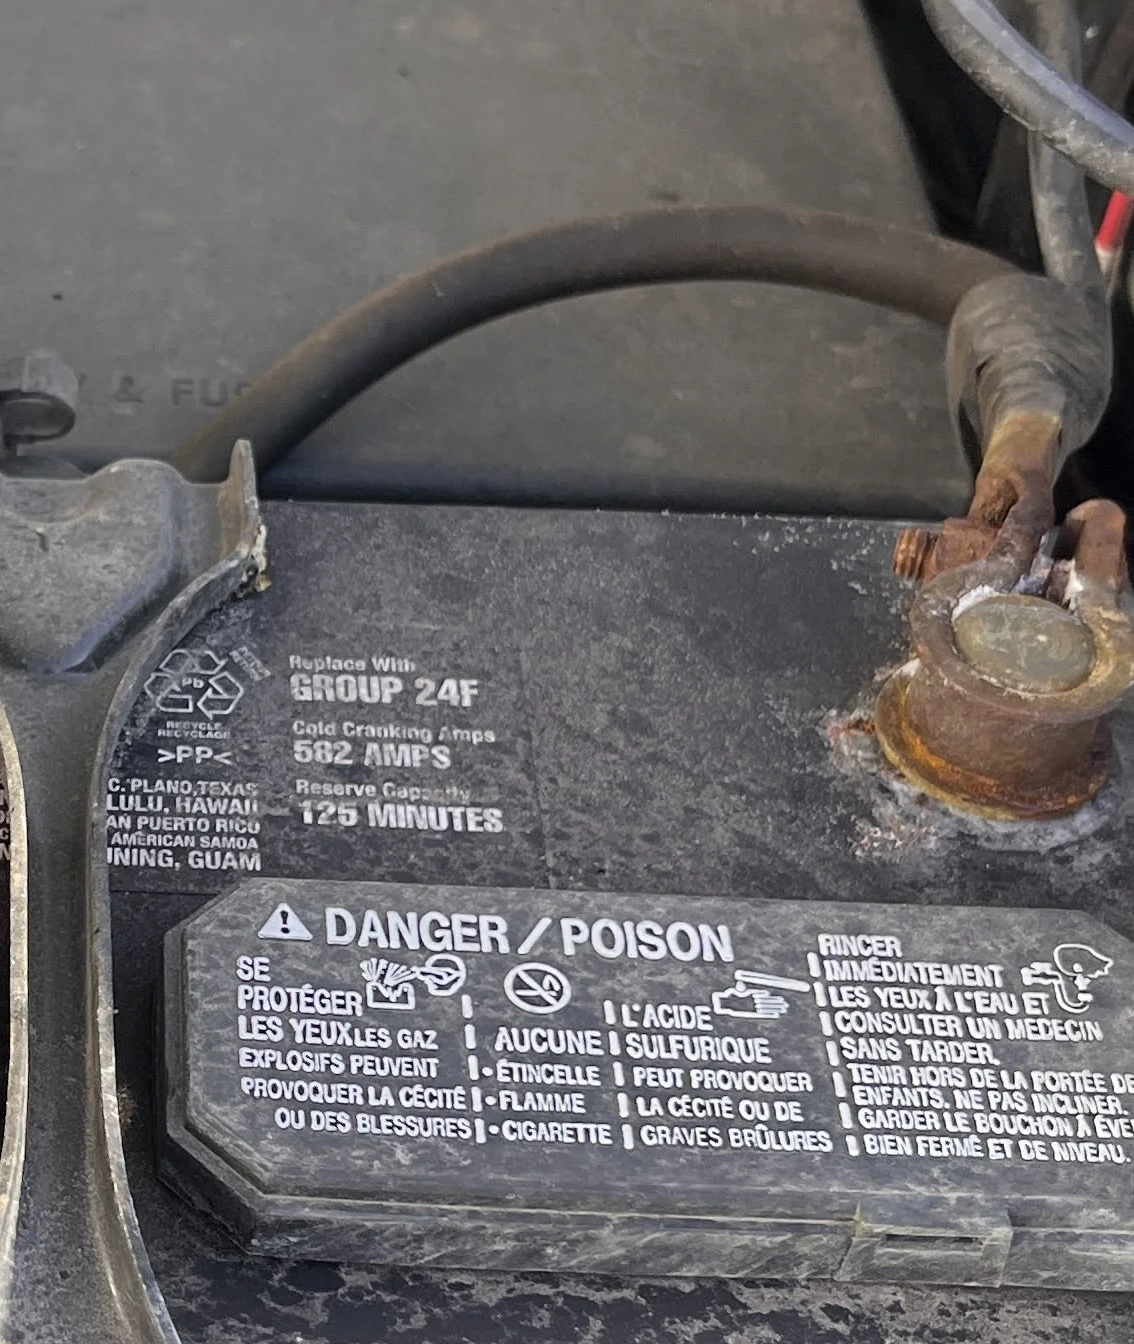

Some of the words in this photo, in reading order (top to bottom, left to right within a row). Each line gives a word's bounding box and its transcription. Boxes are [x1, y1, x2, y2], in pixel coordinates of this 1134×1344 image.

[290, 655, 366, 672] Replace
[371, 656, 416, 673] With
[289, 674, 403, 704] GROUP
[414, 678, 479, 707] 24F
[292, 720, 337, 737] Cold
[342, 721, 433, 744] Cranking
[438, 726, 496, 745] Amps
[293, 739, 354, 765] 582
[364, 742, 452, 770] AMPS
[295, 778, 377, 797] Reserve
[175, 796, 259, 815] HAWAII
[298, 800, 359, 827] 125
[367, 803, 505, 833] MINUTES
[136, 815, 211, 832] PUERTO
[216, 817, 262, 834] RICO
[110, 832, 196, 848] AMERICAN
[199, 835, 259, 851] SAMOA
[187, 850, 262, 872] GUAM
[324, 906, 511, 954] DANGER
[560, 917, 736, 963] POISON
[817, 933, 903, 958] RINCER
[236, 955, 272, 983] SE
[823, 957, 1005, 988] IMMÉDIATEMENT
[237, 983, 364, 1017] PROTÉGER
[828, 985, 871, 1009] LES
[873, 986, 933, 1011] YEUX
[954, 991, 1020, 1016] L'EAU
[1022, 992, 1050, 1016] ET
[237, 1014, 285, 1043] LES
[289, 1018, 354, 1048] YEUX
[353, 1027, 393, 1049] LES
[397, 1028, 440, 1051] GAZ
[621, 1003, 714, 1032] L'ACIDE
[833, 1010, 964, 1039] CONSULTER
[966, 1016, 1002, 1041] UN
[494, 1026, 605, 1056] AUCUNE
[625, 1032, 773, 1065] SULFURIQUE
[839, 1037, 904, 1061] SANS
[904, 1038, 1001, 1066] TARDER.
[238, 1046, 346, 1076] EXPLOSIFS
[349, 1053, 440, 1079] PEUVENT
[496, 1057, 603, 1088] ÉTINCELLE
[846, 1062, 908, 1086] TENIR
[910, 1065, 967, 1089] HORS
[969, 1068, 999, 1091] DE
[1001, 1070, 1028, 1092] LA
[1030, 1068, 1109, 1094] PORTÉE
[240, 1076, 365, 1107] PROVOQUER
[367, 1085, 396, 1108] LA
[398, 1083, 468, 1111] CÉCITÉ
[632, 1065, 685, 1089] PEUT
[690, 1068, 814, 1094] PROVOQUER
[498, 1089, 587, 1114] FLAMME
[636, 1096, 664, 1118] LA
[667, 1094, 736, 1120] CÉCITÉ
[738, 1100, 770, 1122] OU
[774, 1101, 806, 1123] DE
[851, 1084, 951, 1110] ENFANTS.
[953, 1089, 986, 1111] NE
[987, 1090, 1029, 1114] PAS
[1032, 1093, 1130, 1117] INCLINER.
[274, 1107, 306, 1131] OU
[310, 1110, 352, 1134] DES
[356, 1113, 473, 1140] BLESSURES
[501, 1119, 614, 1146] CIGARETTE
[639, 1126, 723, 1149] GRAVES
[728, 1123, 835, 1154] BRÛLURES
[857, 1109, 942, 1133] GARDER
[943, 1111, 971, 1134] LE
[973, 1112, 1075, 1138] BOUCHON
[862, 1134, 914, 1158] BIEN
[915, 1134, 985, 1159] FERMÉ
[986, 1137, 1014, 1160] ET
[1017, 1139, 1050, 1162] DE
[1051, 1140, 1132, 1165] NIVEAU.
